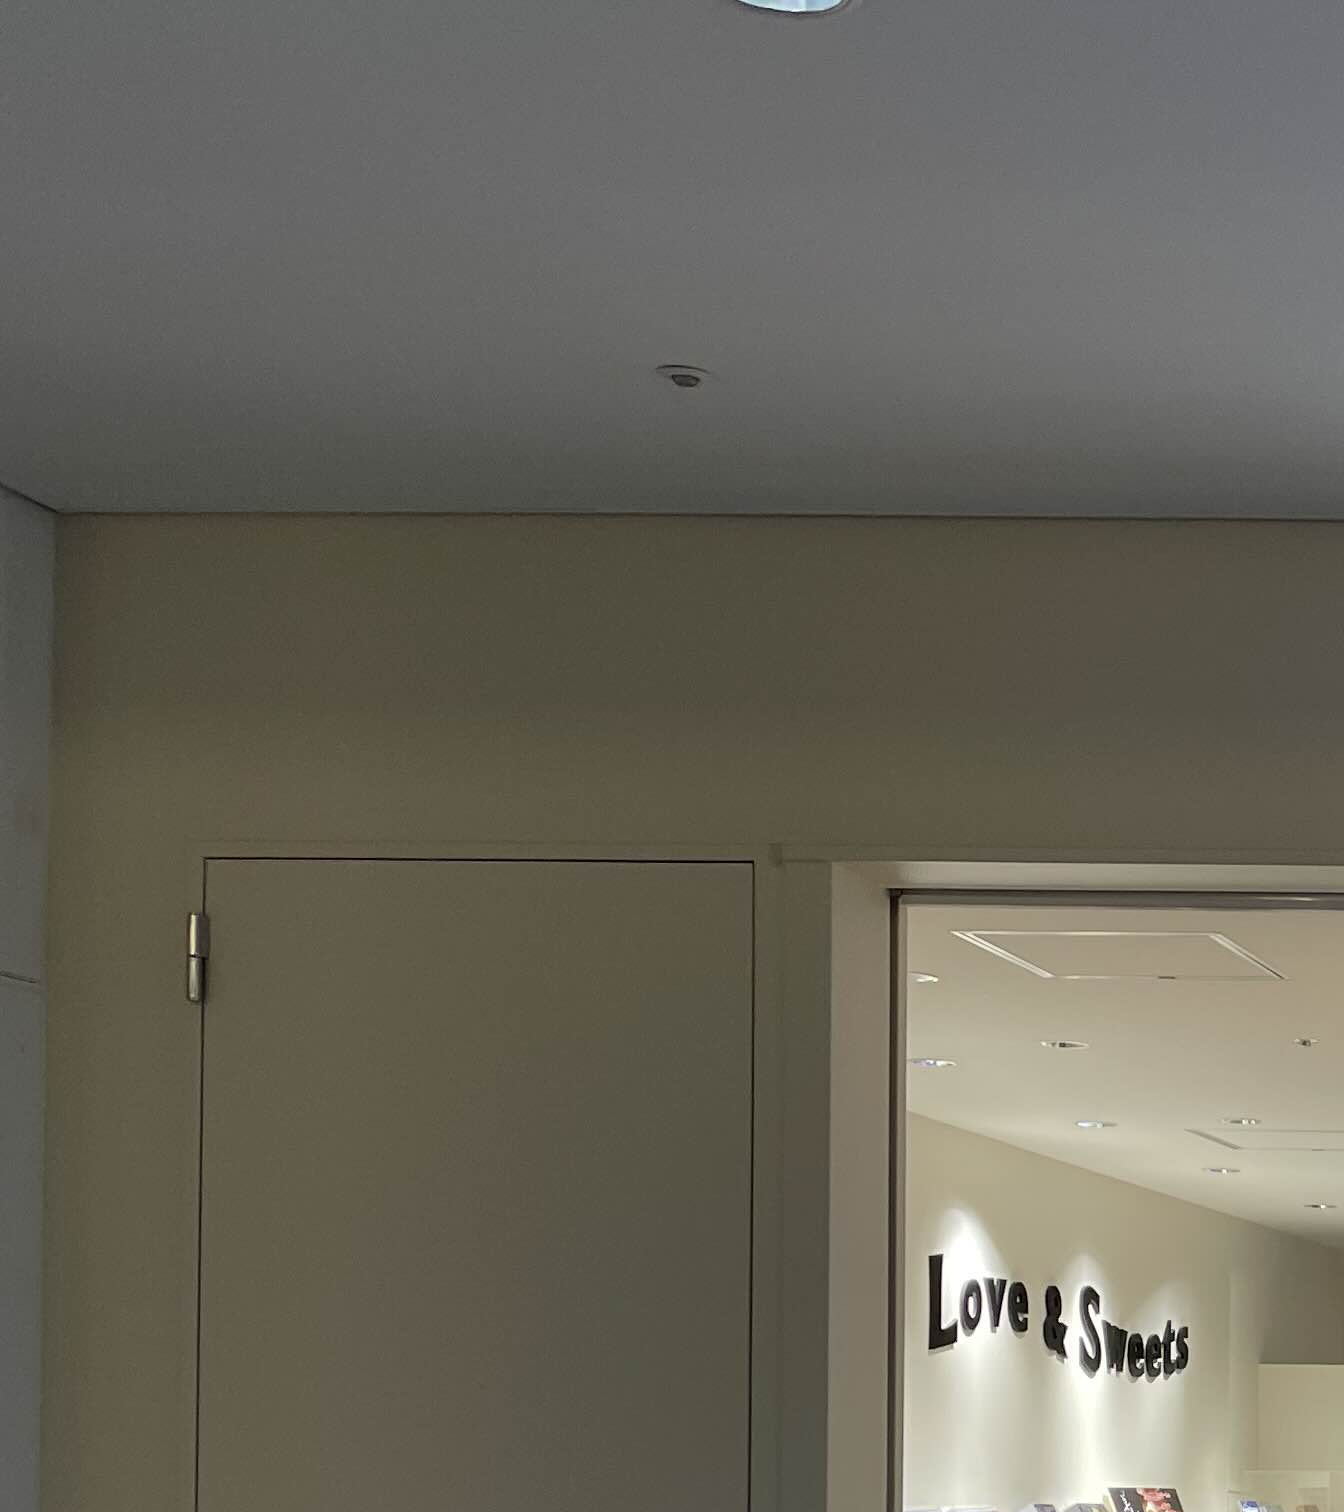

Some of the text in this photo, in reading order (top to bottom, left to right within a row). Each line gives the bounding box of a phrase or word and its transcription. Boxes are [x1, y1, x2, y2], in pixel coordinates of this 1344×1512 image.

[928, 1253, 1189, 1375] Love & Sweets
